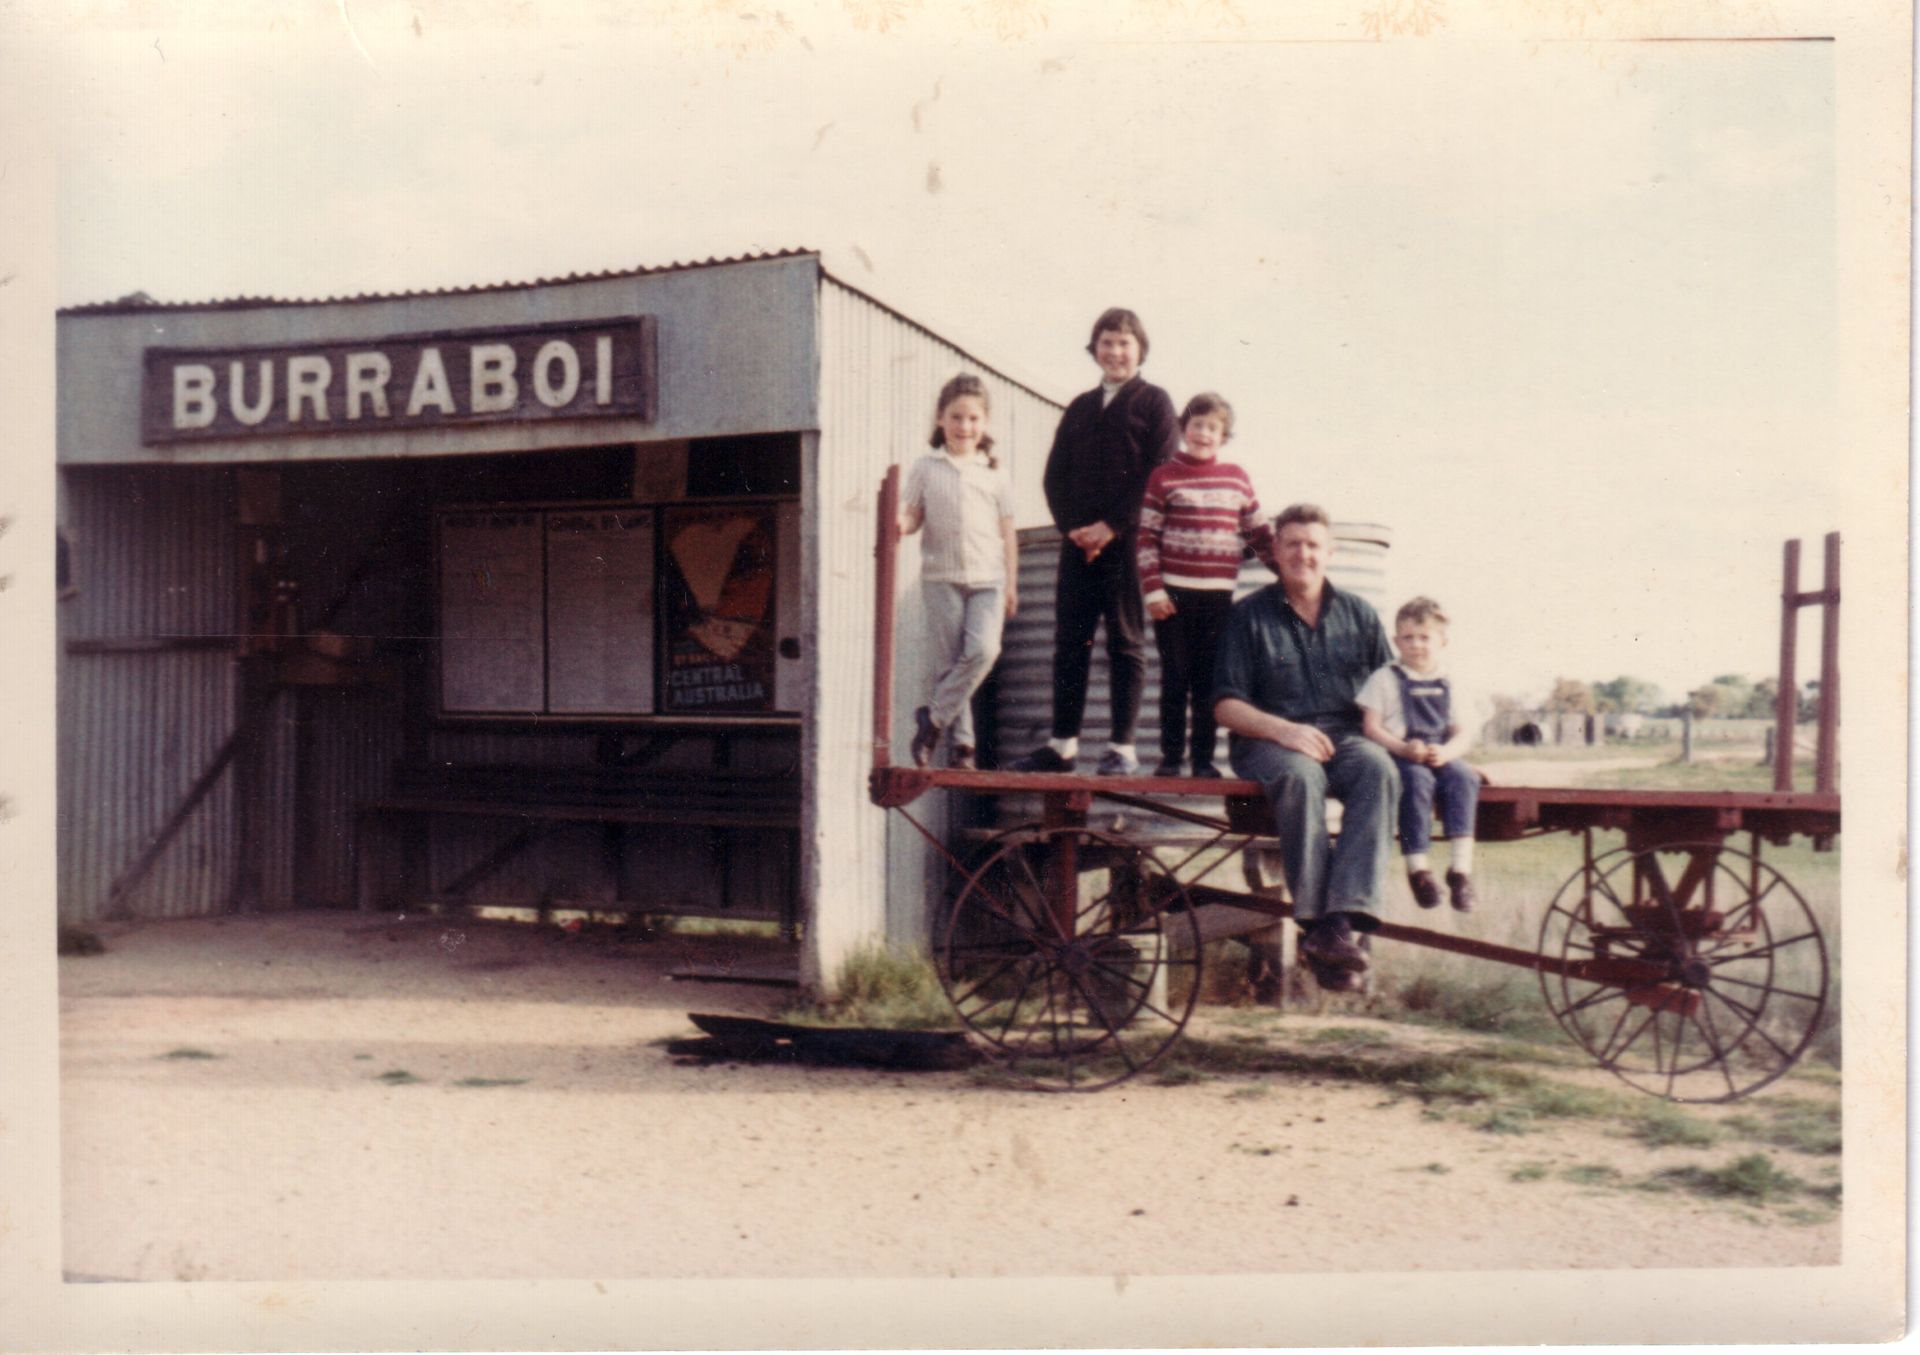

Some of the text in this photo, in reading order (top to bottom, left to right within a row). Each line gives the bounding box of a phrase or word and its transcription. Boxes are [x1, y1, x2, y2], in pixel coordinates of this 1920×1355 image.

[172, 336, 612, 430] BURRABOI
[672, 667, 743, 687] CENTRAL
[673, 682, 764, 704] AUSTRALIA
